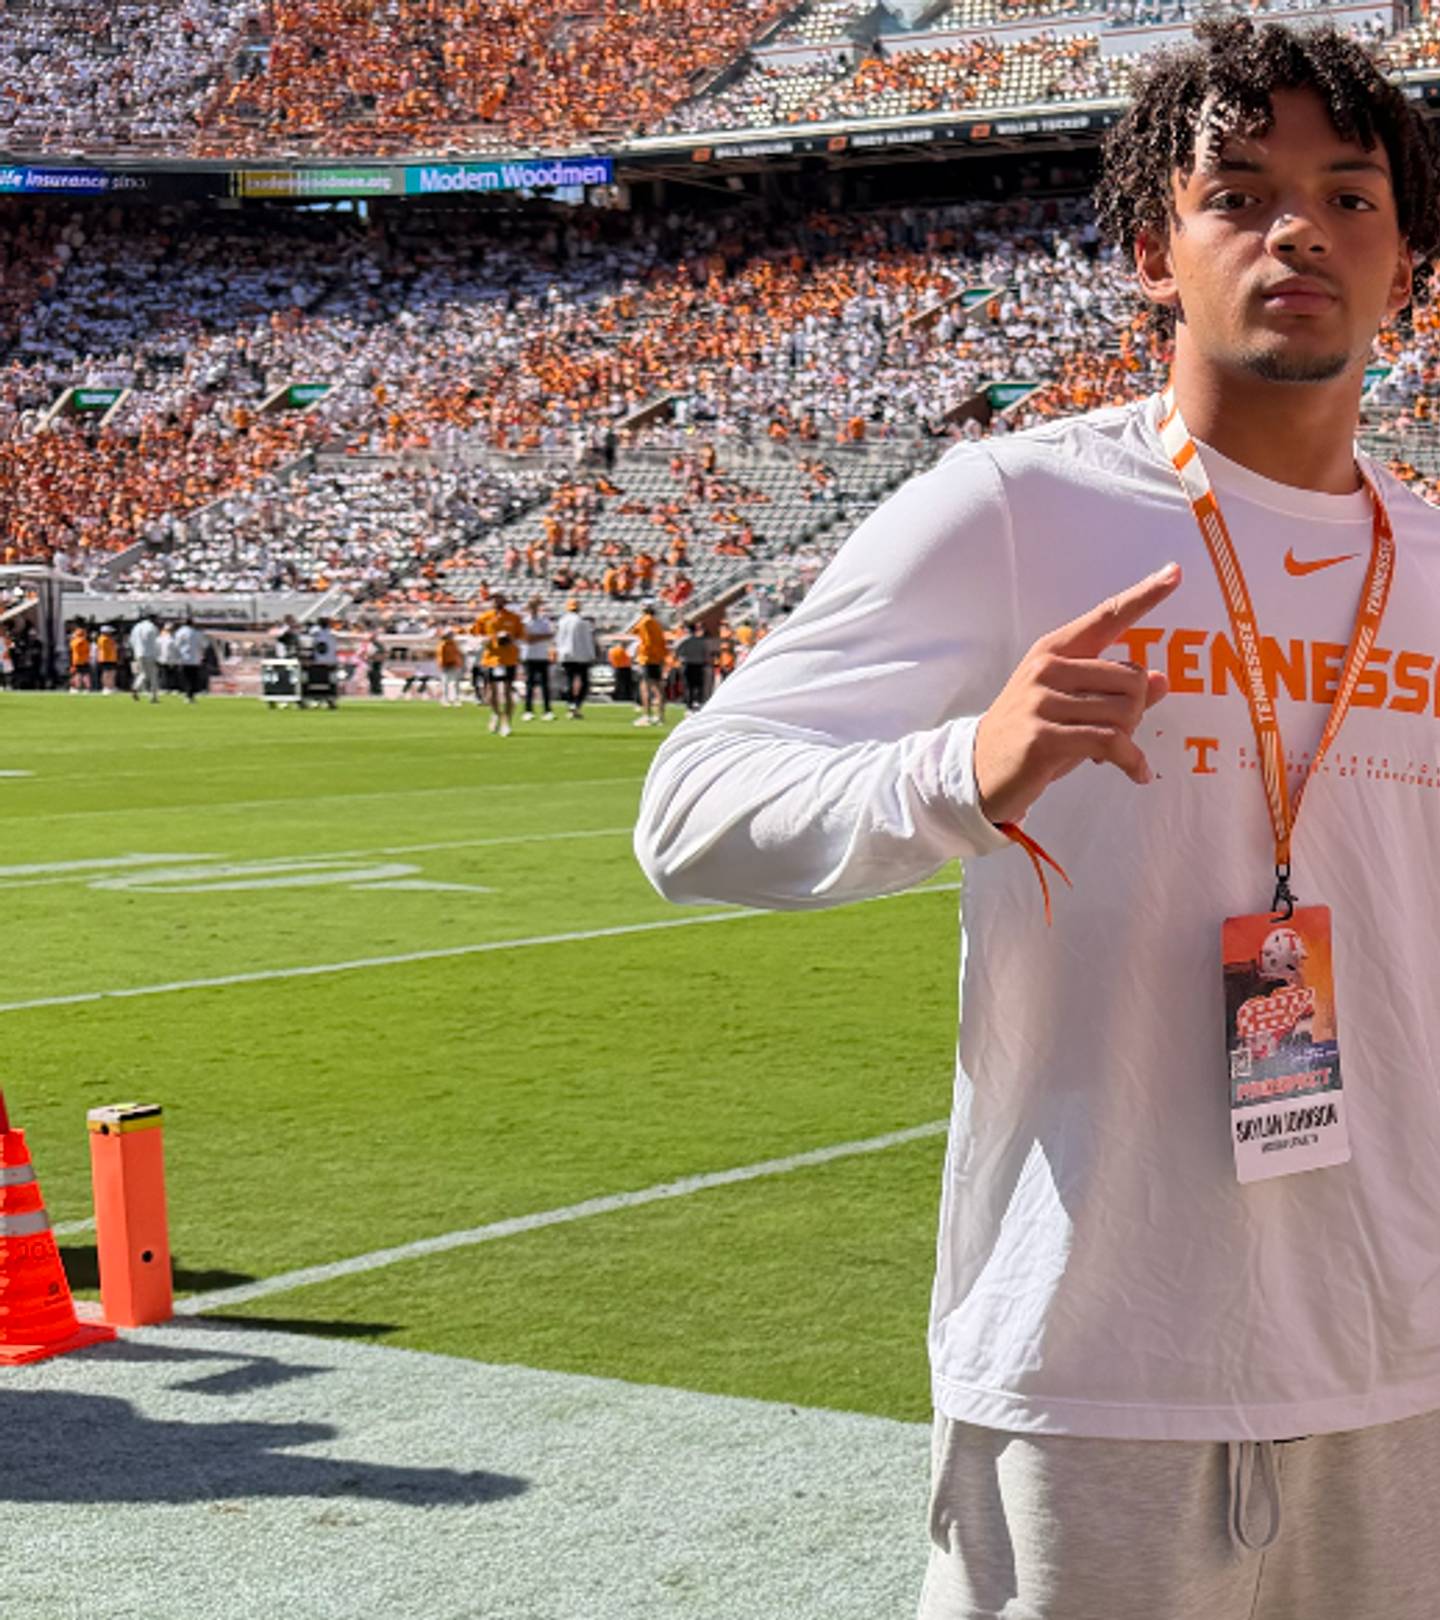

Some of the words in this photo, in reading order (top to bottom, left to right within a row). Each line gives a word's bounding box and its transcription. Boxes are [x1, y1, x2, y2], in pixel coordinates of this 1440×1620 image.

[26, 170, 108, 189] Insurance
[419, 165, 499, 191] Modern
[501, 162, 607, 187] Woodmen
[1237, 620, 1276, 724] TENNESSEE
[1184, 737, 1219, 773] T
